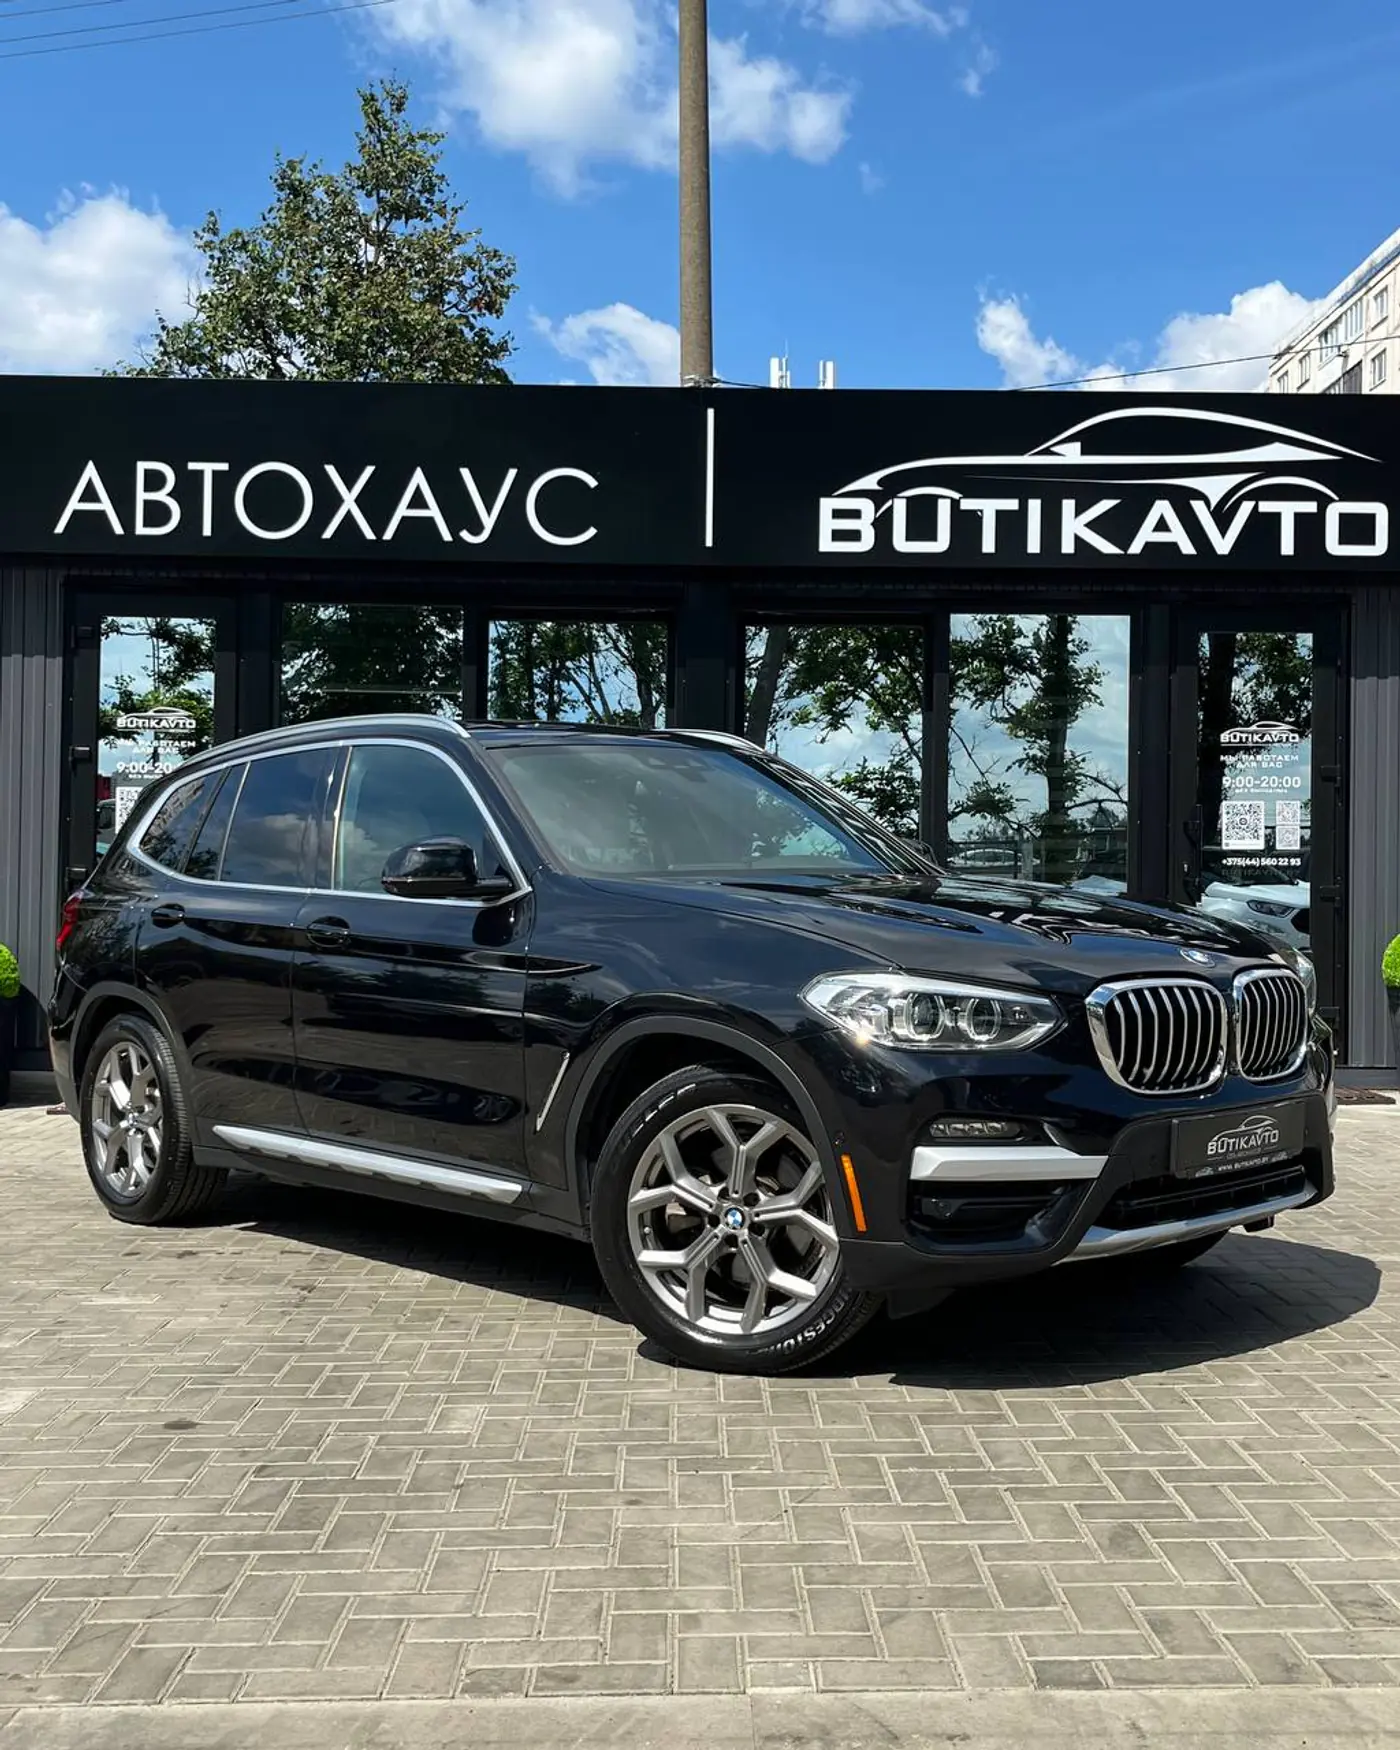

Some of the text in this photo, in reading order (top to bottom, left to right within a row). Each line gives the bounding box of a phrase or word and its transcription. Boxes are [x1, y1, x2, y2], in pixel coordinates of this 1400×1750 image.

[53, 459, 600, 547] АВТОХАУС
[818, 496, 1389, 557] BUTIKAVTO
[116, 717, 196, 729] BUTIKAVTO
[1220, 732, 1299, 743] BUTIKAVTO
[1222, 775, 1302, 788] 9:00-20:00
[1278, 857, 1289, 866] 22
[1289, 857, 1302, 866] 93
[1207, 1129, 1280, 1156] BUTIKAVTO
